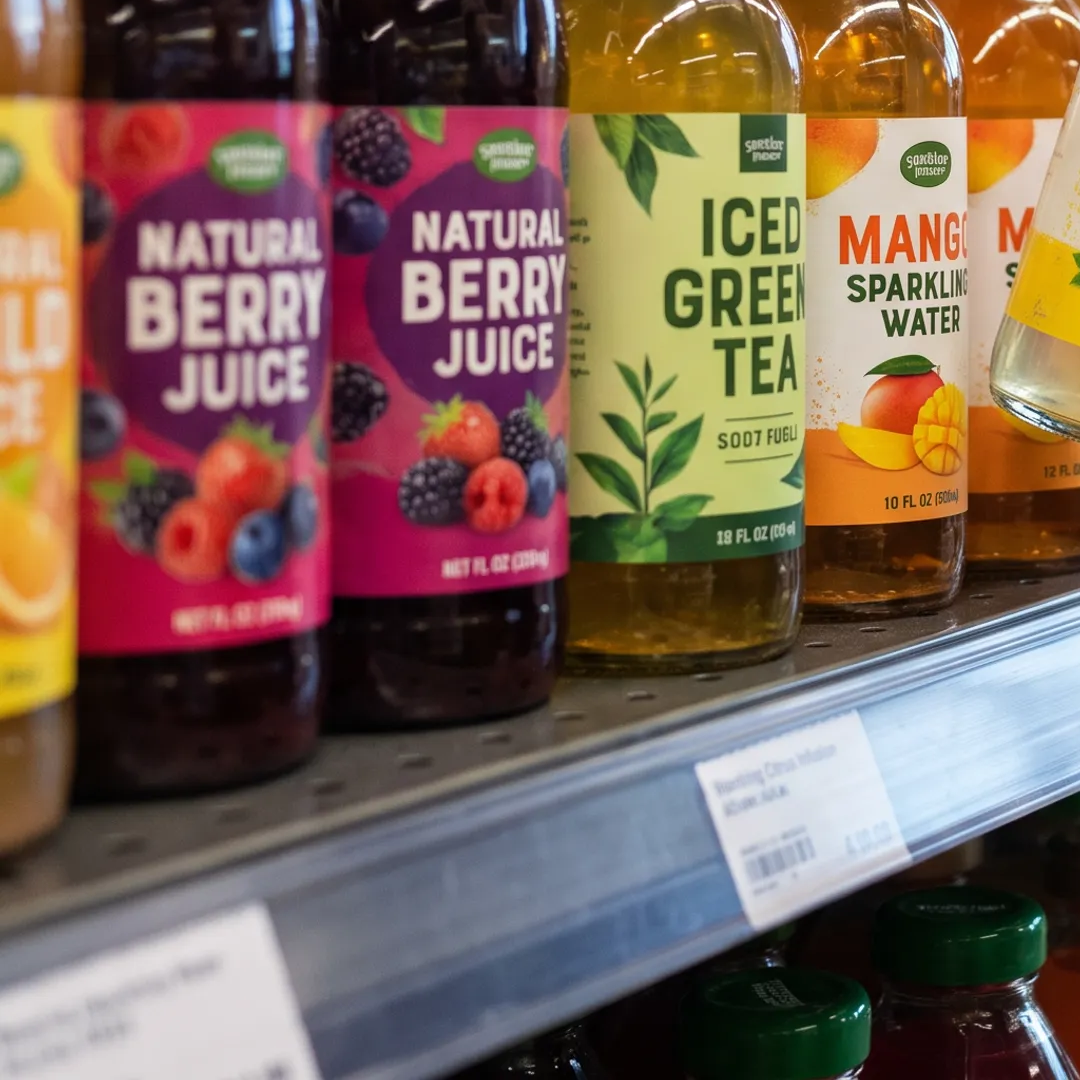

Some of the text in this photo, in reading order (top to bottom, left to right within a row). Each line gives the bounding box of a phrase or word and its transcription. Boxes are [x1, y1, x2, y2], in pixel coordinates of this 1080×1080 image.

[137, 217, 323, 271] NATURAL
[412, 208, 564, 253] NATURAL
[703, 197, 800, 257] ICED
[126, 268, 326, 353] BERRY
[402, 253, 566, 324] BERRY
[664, 263, 805, 329] GREEN
[847, 267, 968, 303] SPARKLING
[881, 304, 960, 337] WATER
[432, 322, 554, 379] JUICE
[713, 334, 797, 397] TEA
[161, 345, 310, 414] JUICE
[884, 496, 899, 510] 10
[902, 494, 917, 508] FL
[919, 493, 932, 507] OZ
[735, 528, 751, 544] FL
[753, 525, 768, 542] OZ
